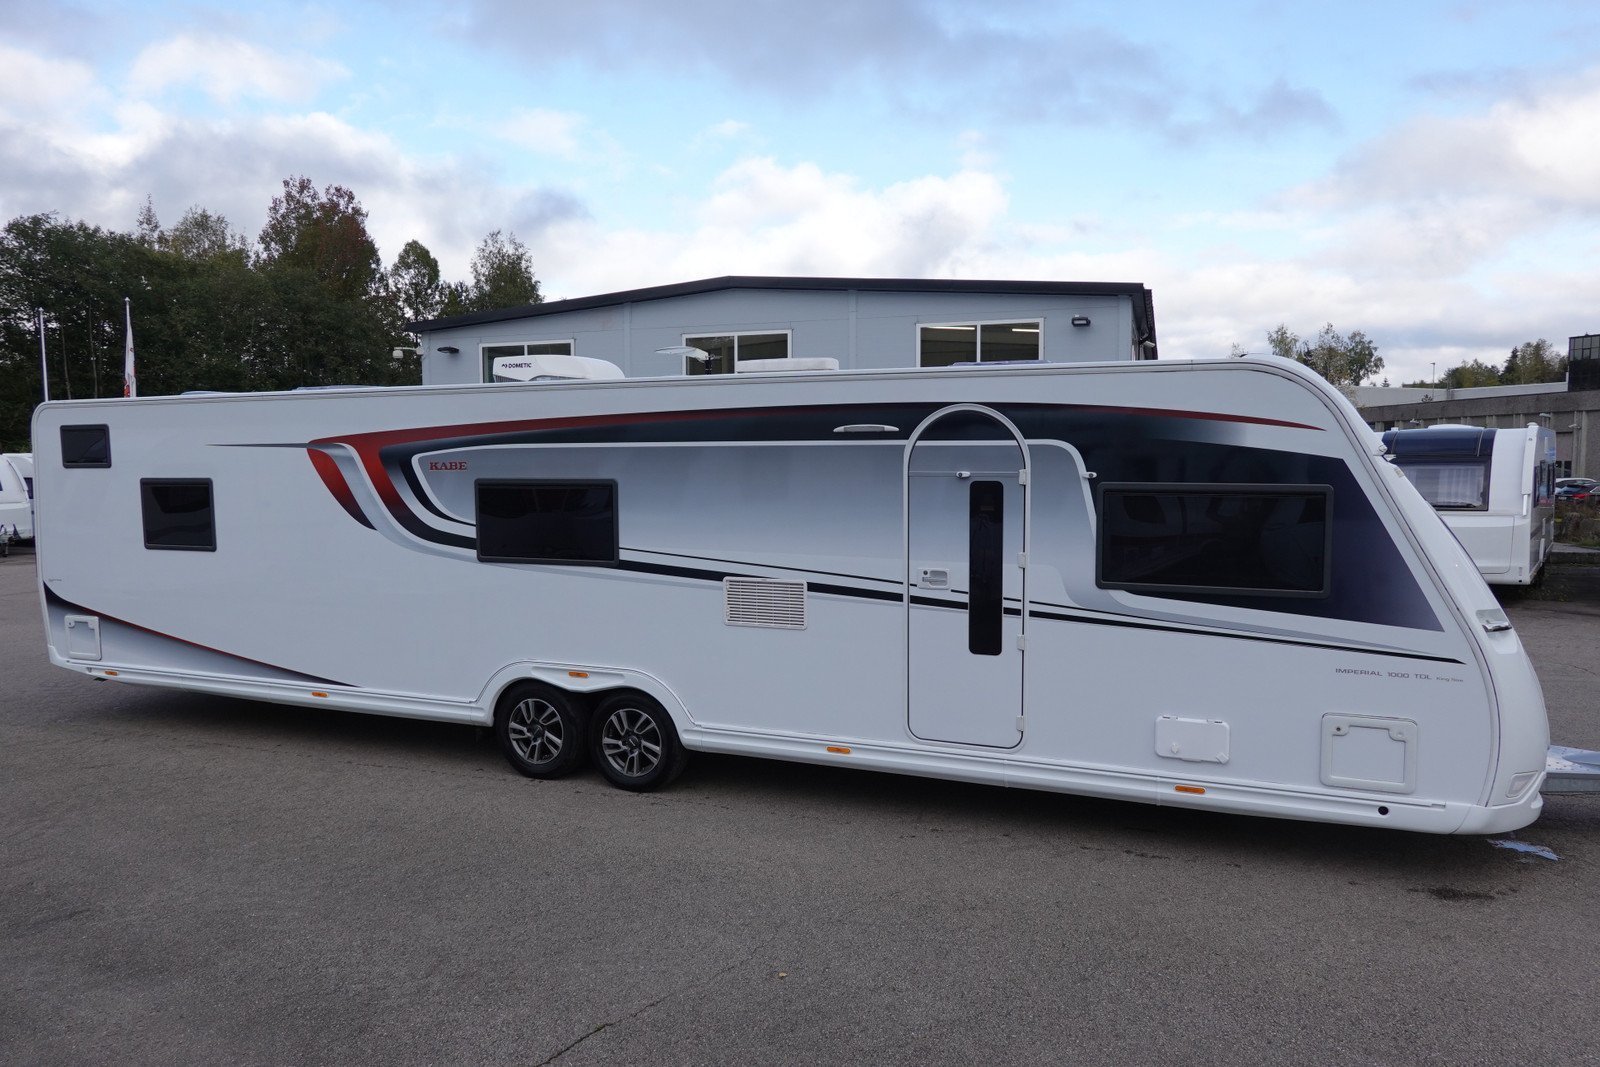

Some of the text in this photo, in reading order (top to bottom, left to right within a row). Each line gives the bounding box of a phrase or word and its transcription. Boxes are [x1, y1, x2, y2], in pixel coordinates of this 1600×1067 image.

[429, 461, 467, 471] KABE
[1335, 668, 1383, 677] IMPERIAL
[1387, 671, 1410, 679] 1000
